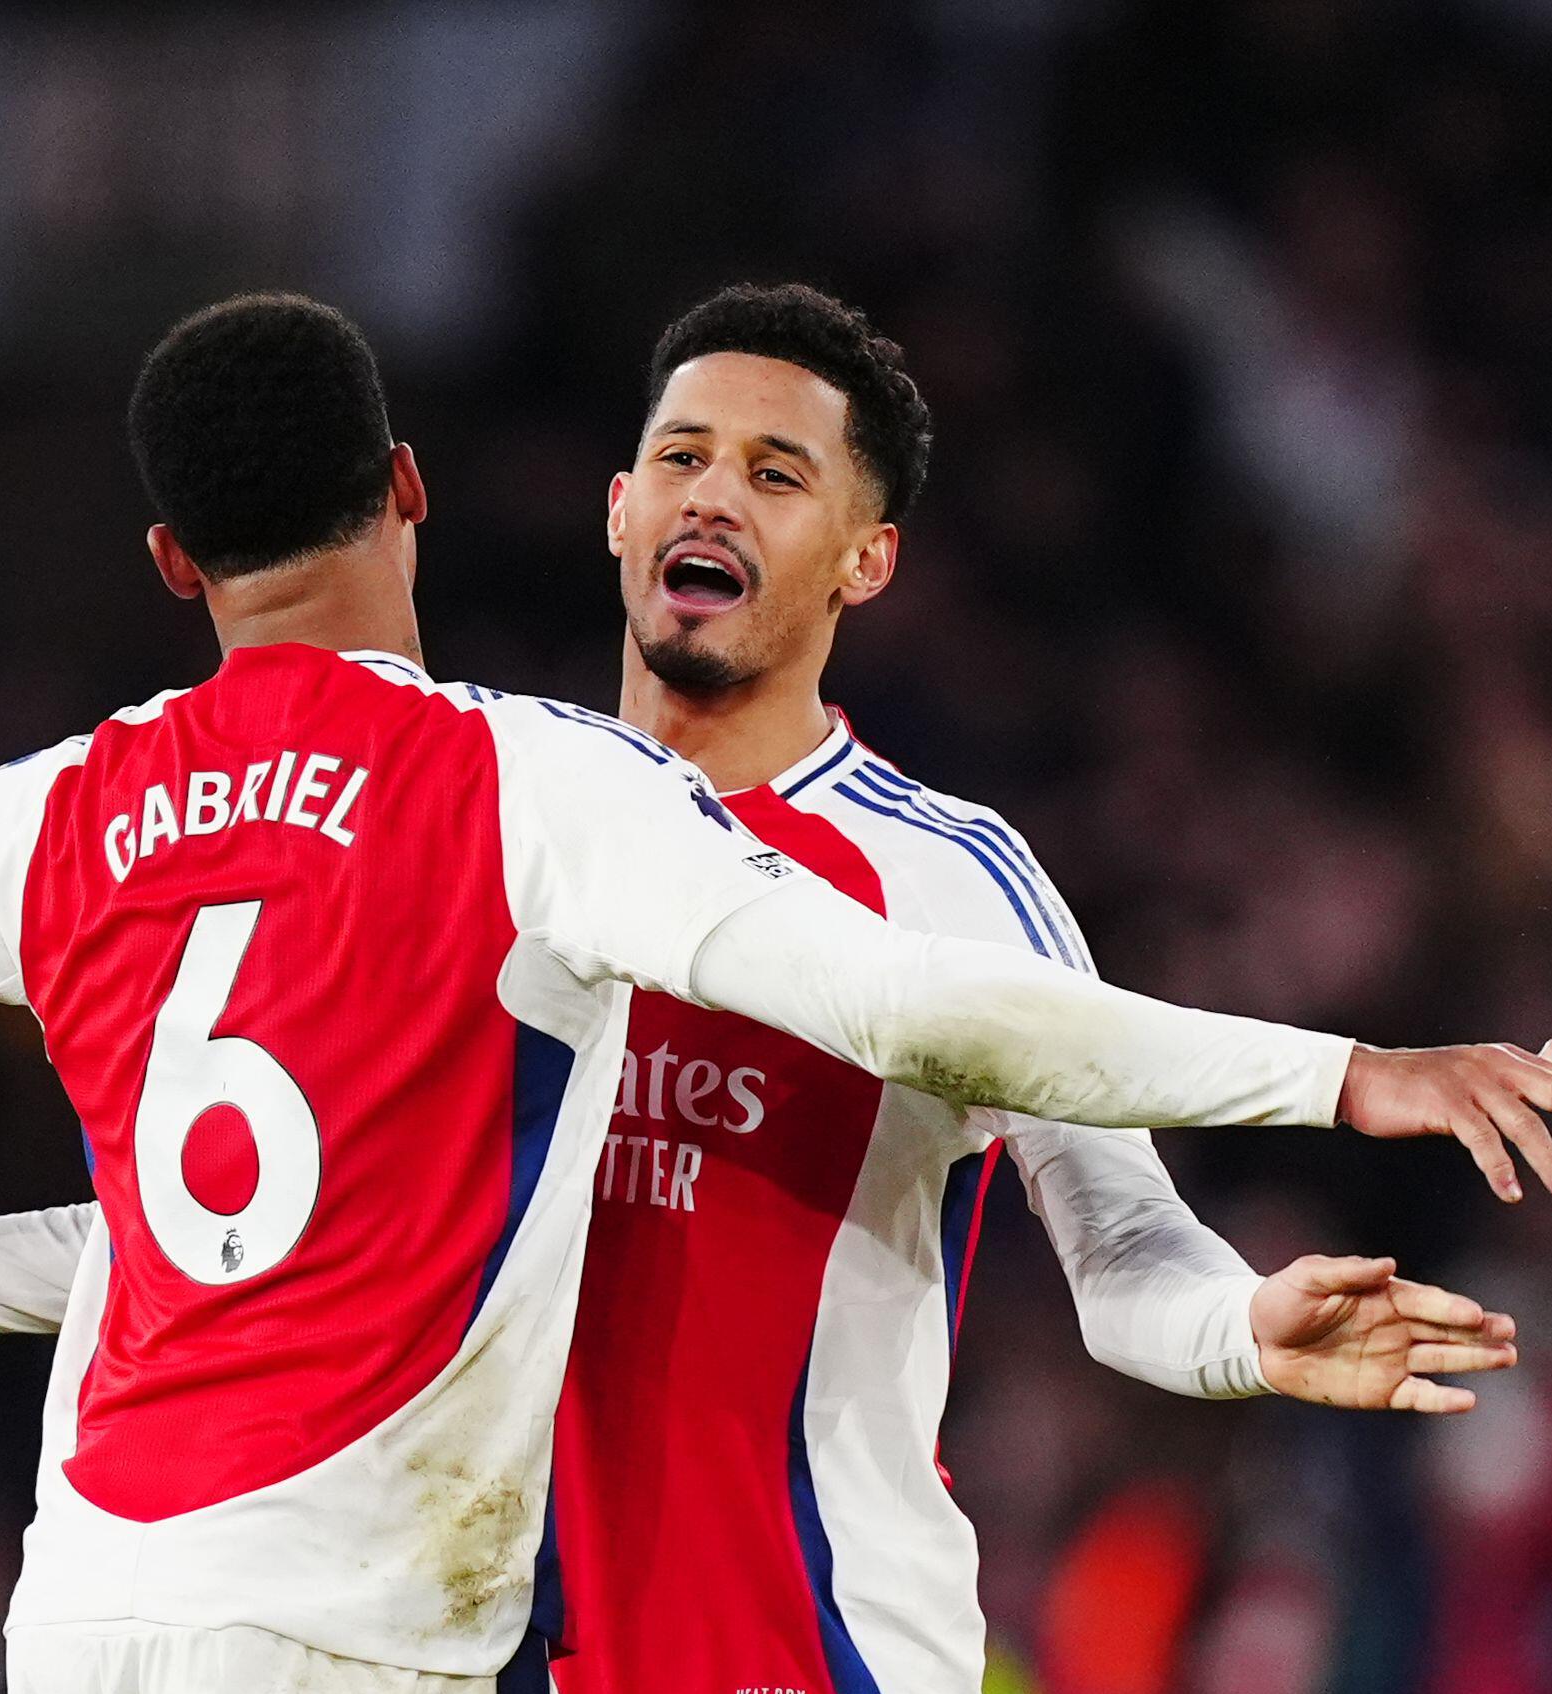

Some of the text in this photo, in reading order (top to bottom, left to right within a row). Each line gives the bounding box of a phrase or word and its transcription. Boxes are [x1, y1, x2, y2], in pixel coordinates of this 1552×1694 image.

[103, 750, 369, 883] GABRIEL
[133, 899, 322, 1286] 6
[611, 1039, 766, 1134] ates
[602, 1133, 703, 1212] TTER
